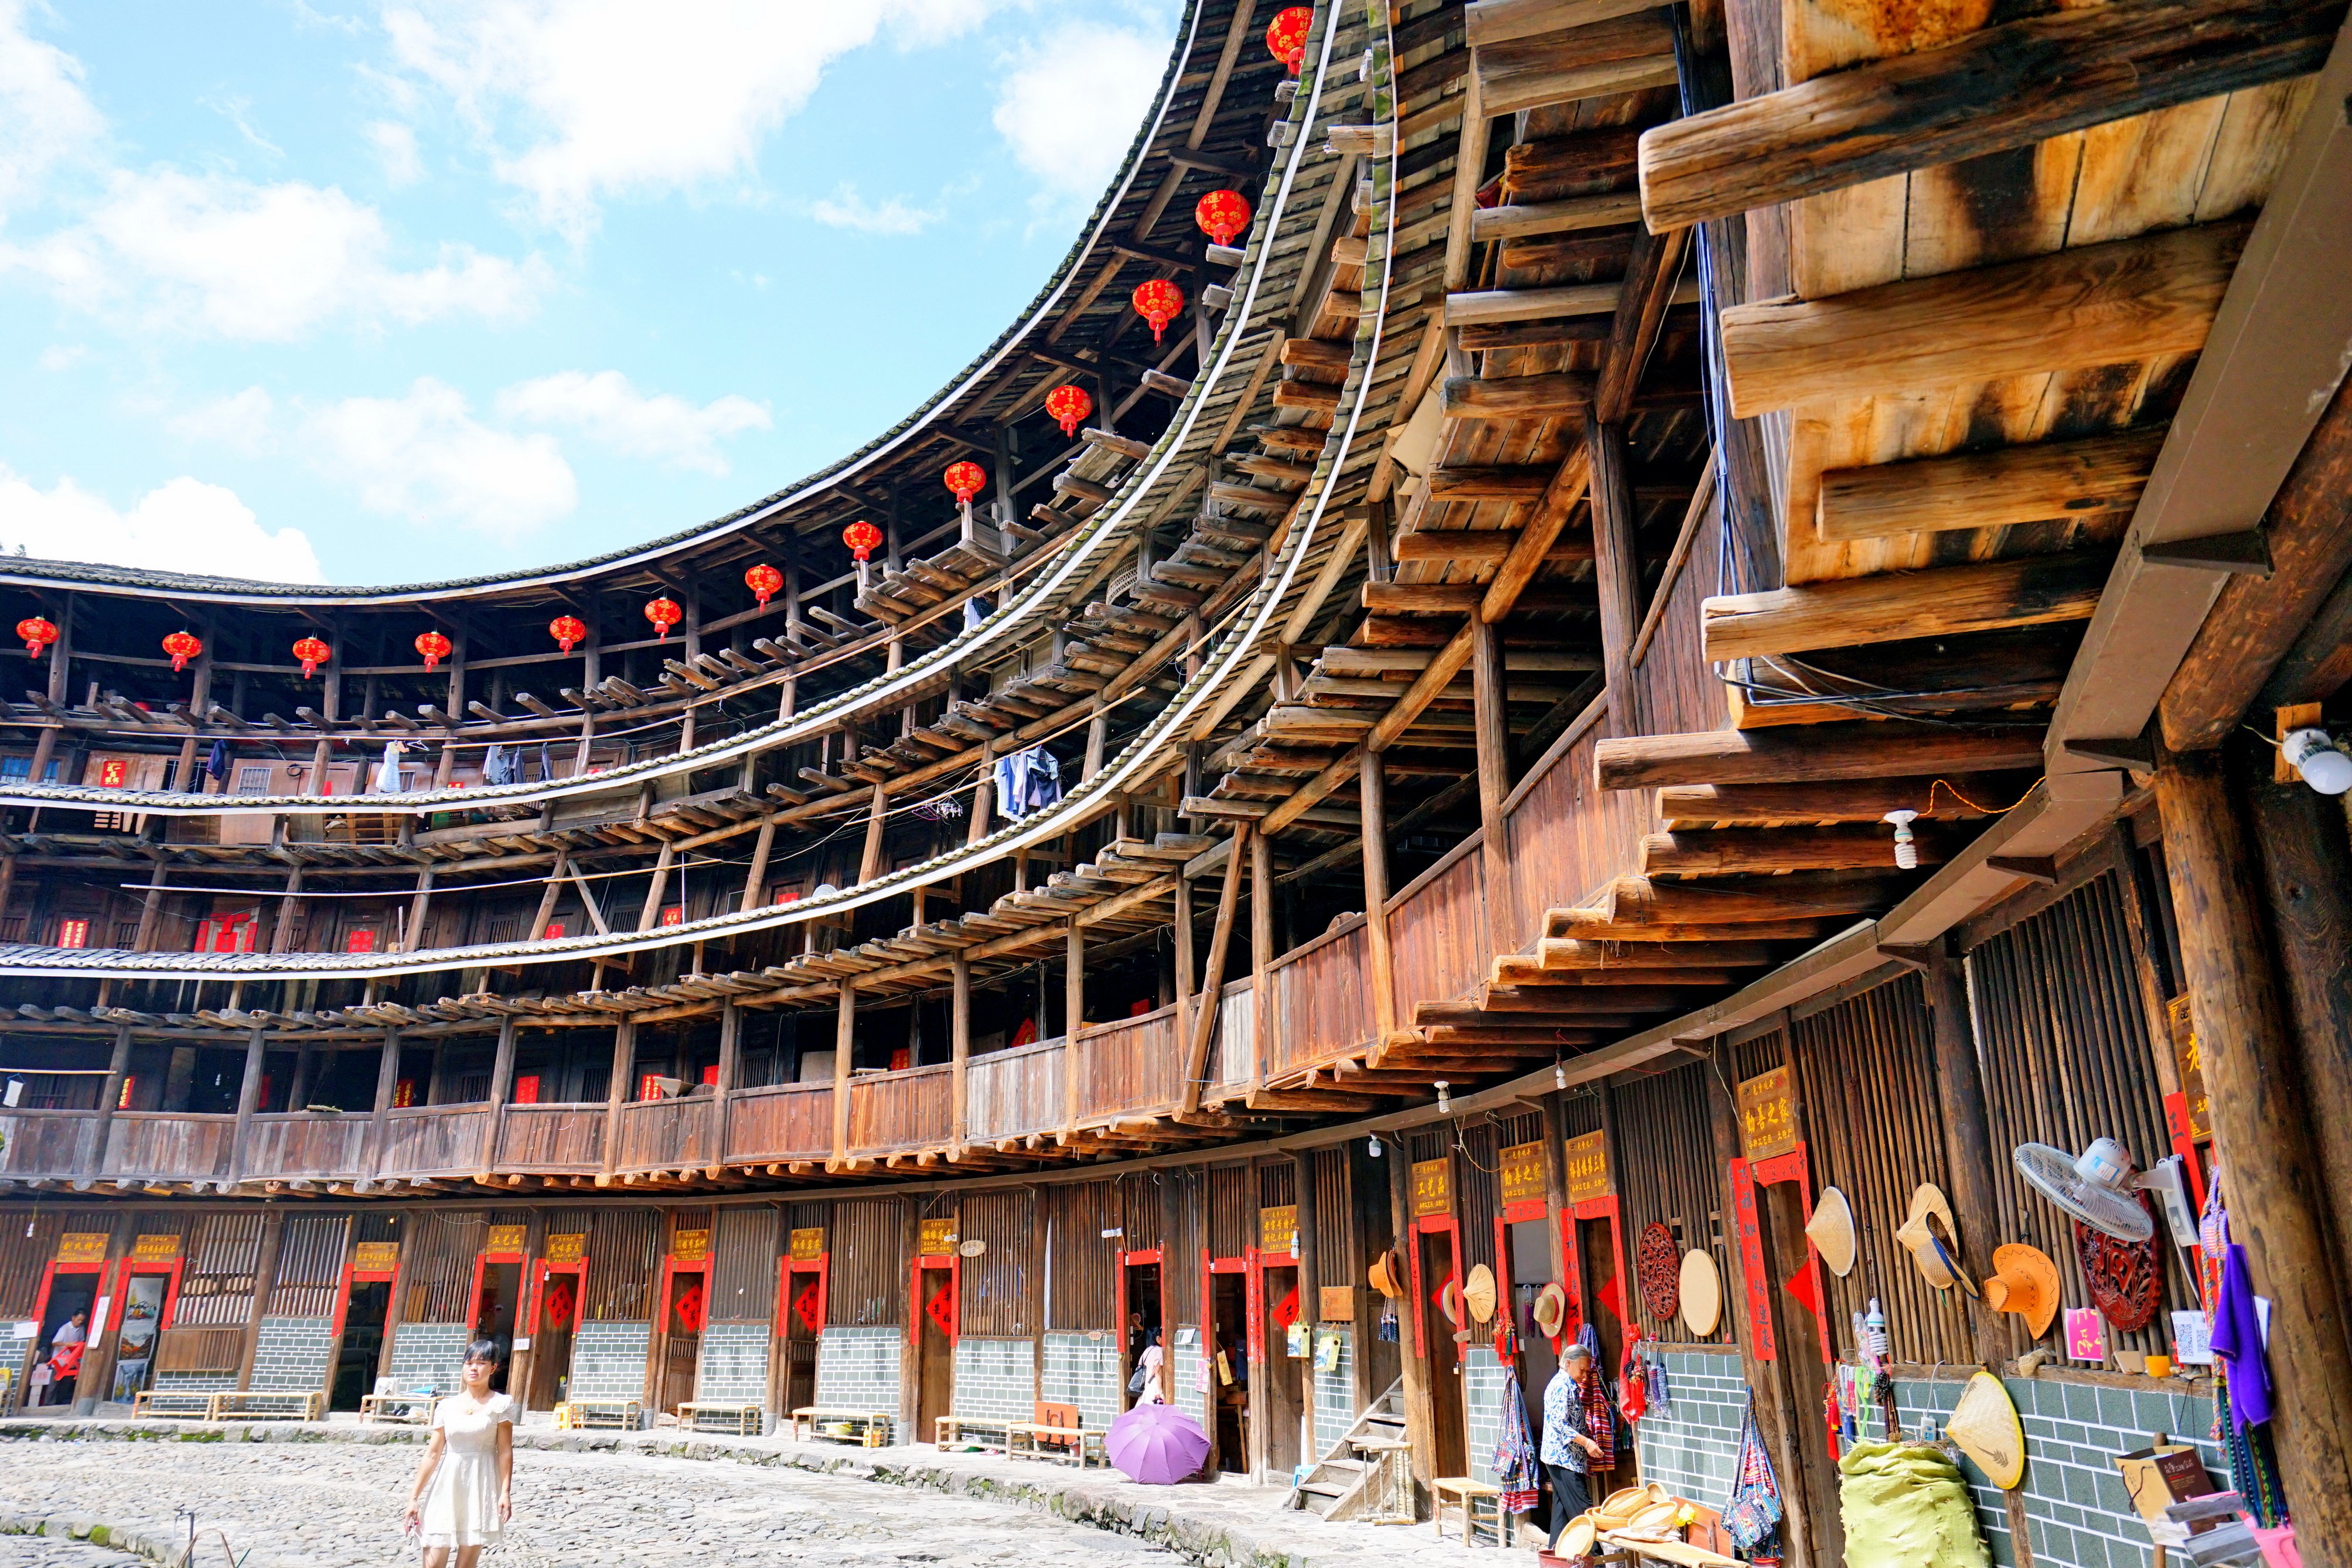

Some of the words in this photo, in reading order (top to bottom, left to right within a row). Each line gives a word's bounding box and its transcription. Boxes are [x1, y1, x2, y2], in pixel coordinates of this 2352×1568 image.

[1746, 1096, 1789, 1134] 勤善之家
[1504, 1162, 1542, 1187] 勤善之家
[1418, 1175, 1444, 1197] 工艺品
[1264, 1219, 1295, 1231] 老字号特产
[492, 1234, 520, 1245] 工艺品
